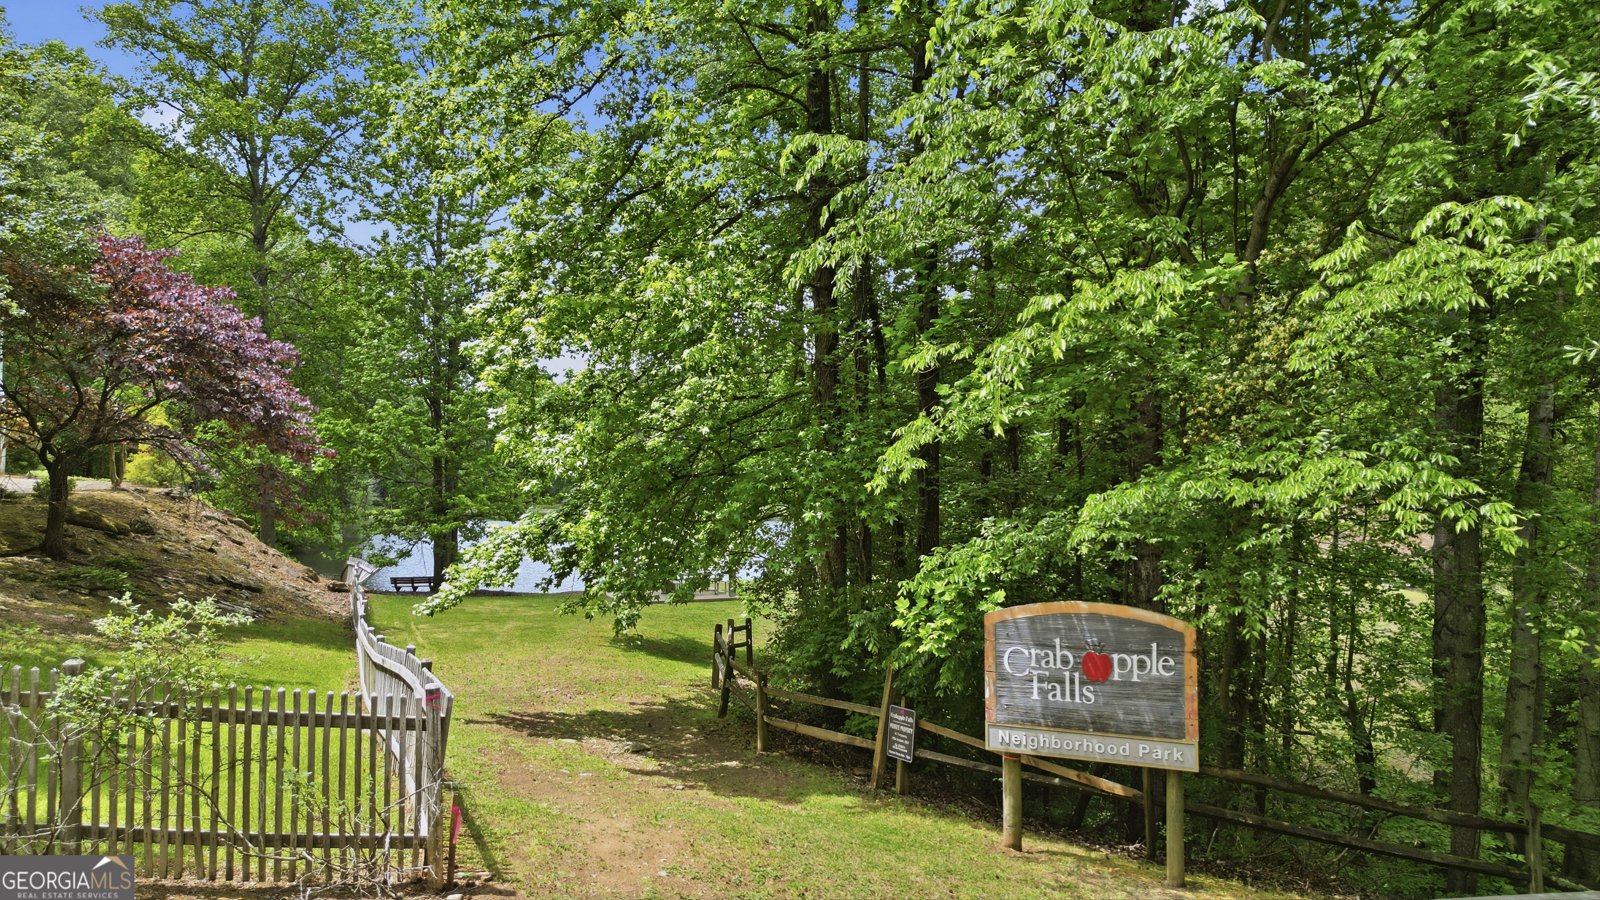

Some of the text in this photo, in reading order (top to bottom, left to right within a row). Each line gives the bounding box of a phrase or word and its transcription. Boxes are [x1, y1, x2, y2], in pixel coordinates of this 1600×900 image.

[1003, 637, 1074, 677] Crab
[1029, 670, 1095, 704] Falls
[998, 729, 1184, 762] Neighborhood Park
